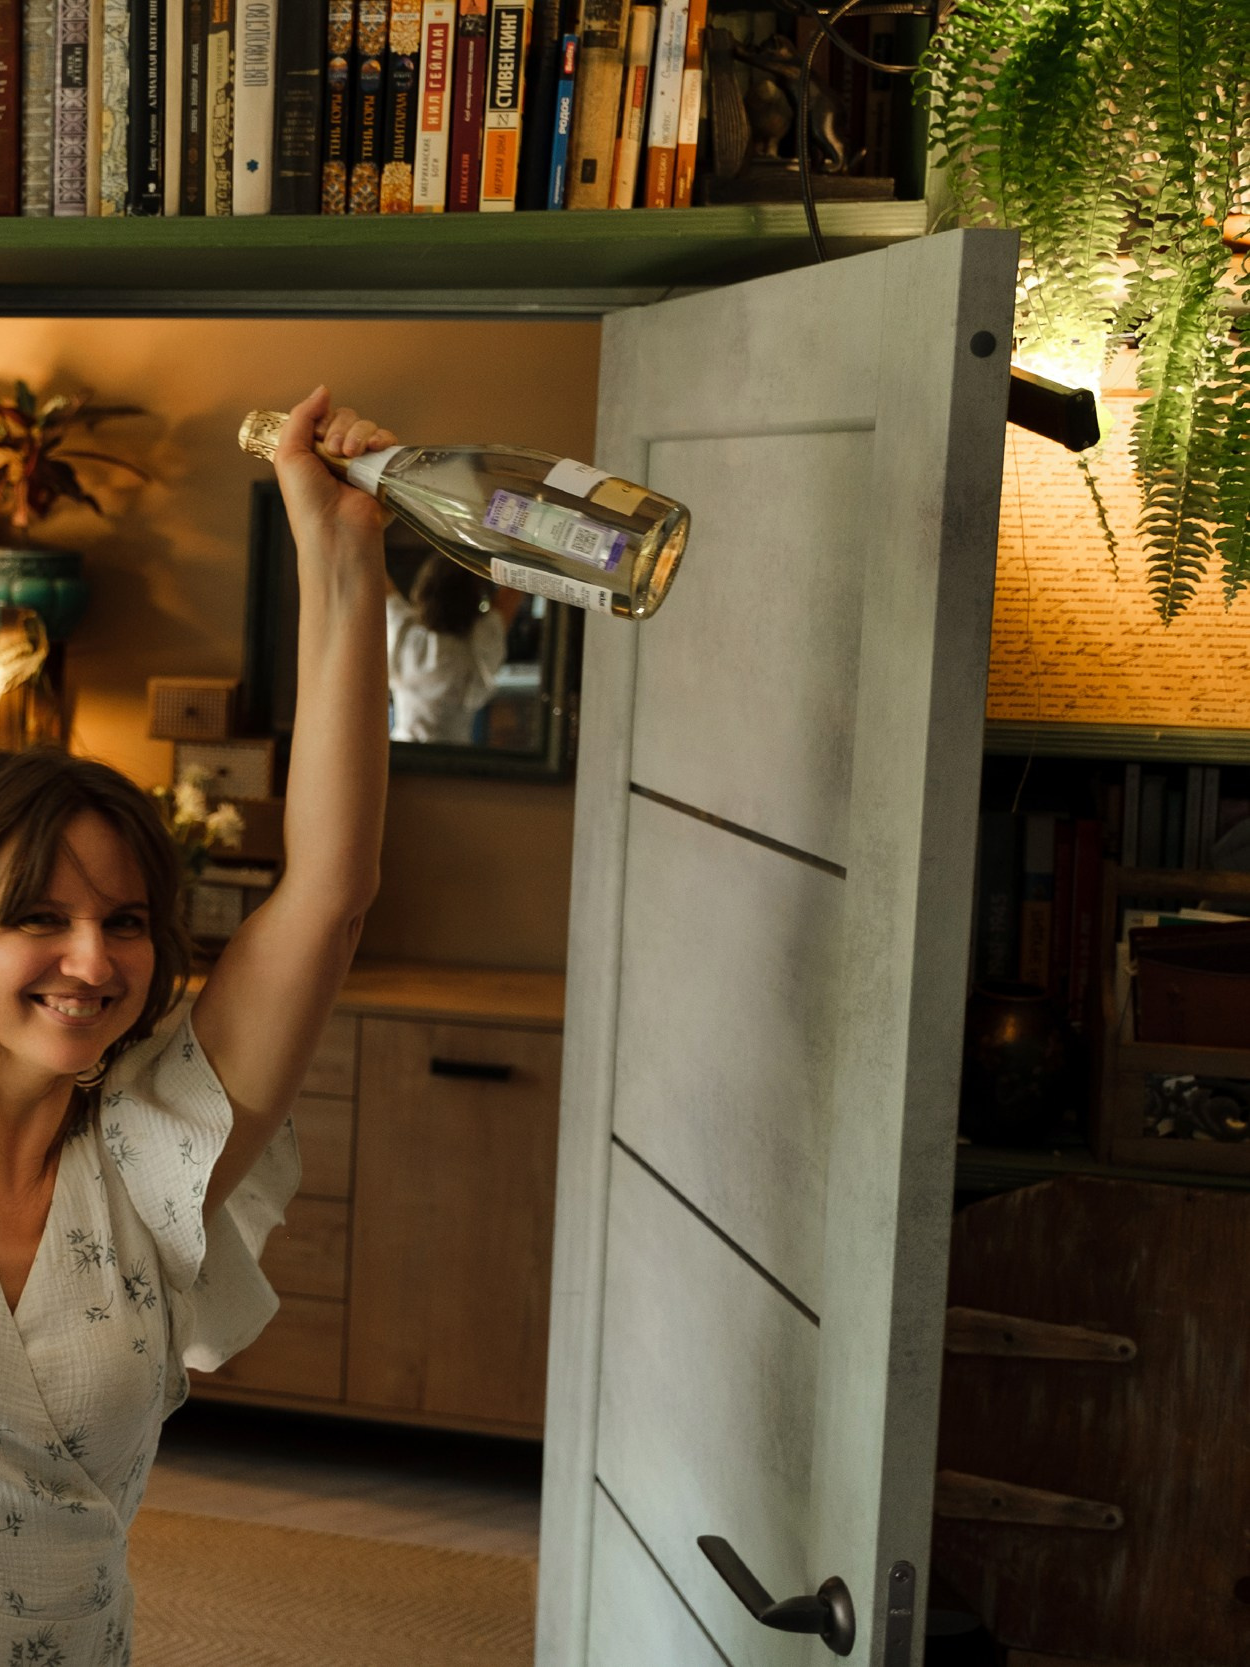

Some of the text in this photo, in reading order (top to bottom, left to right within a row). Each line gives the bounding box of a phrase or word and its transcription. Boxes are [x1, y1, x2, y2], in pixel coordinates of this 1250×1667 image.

[242, 3, 270, 87] ЦВЕТОВОДСТВО
[427, 28, 445, 125] НИЛ ГЕЙМАН
[495, 11, 518, 108] СТИВЕН КИНГ
[148, 54, 158, 108] АЛМАЗНАЯ
[331, 94, 342, 157] ТЕНЬ ГОРЫ
[361, 95, 375, 158] ТЕНЬ ГОРЫ
[393, 92, 407, 159] ШАНТАРАМ
[495, 134, 506, 156] ЗОНА
[558, 97, 570, 135] РОДОС
[420, 137, 431, 197] АМЕРИКАНСКИЕ
[431, 158, 440, 178] БОГИ
